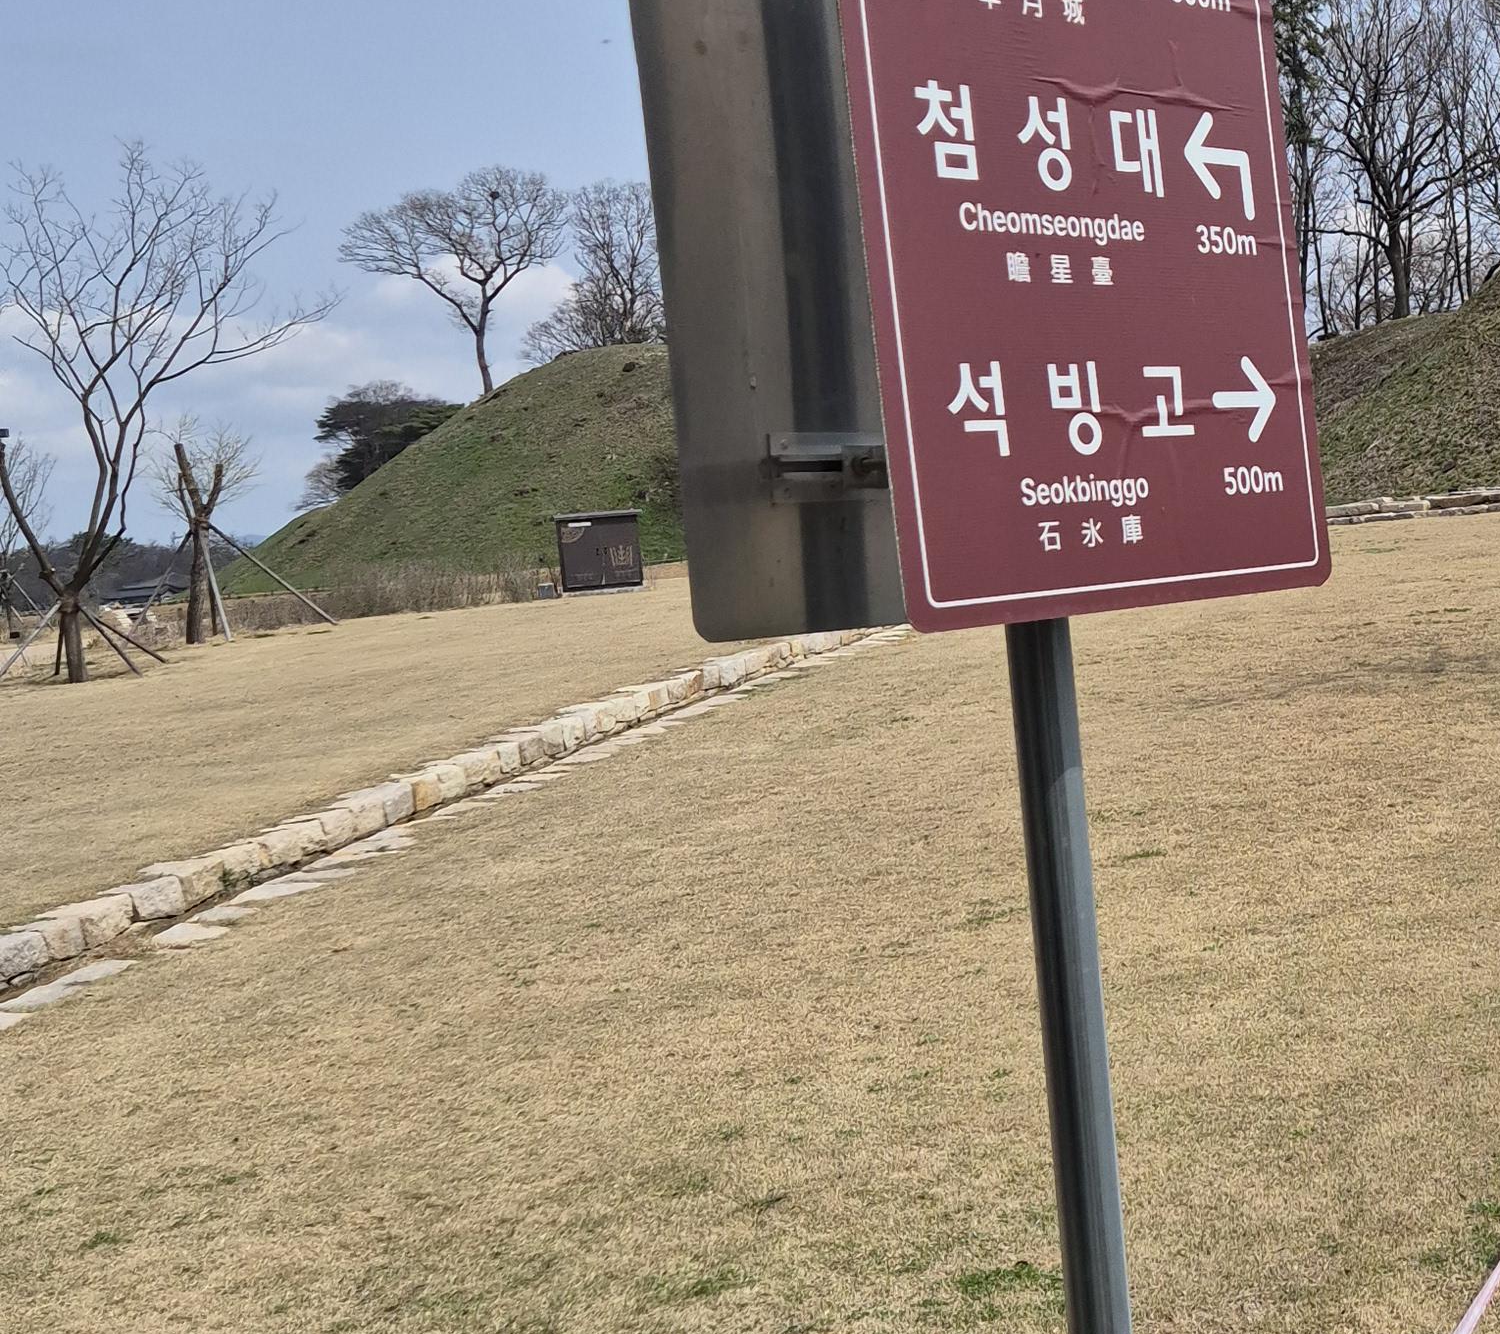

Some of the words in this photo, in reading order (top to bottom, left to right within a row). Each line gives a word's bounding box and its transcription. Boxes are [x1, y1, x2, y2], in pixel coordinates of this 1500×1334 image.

[957, 200, 1146, 247] Cheomseongdae
[1194, 223, 1259, 257] 350m
[1019, 472, 1150, 509] Seokbinggo
[1222, 464, 1285, 497] 500m
